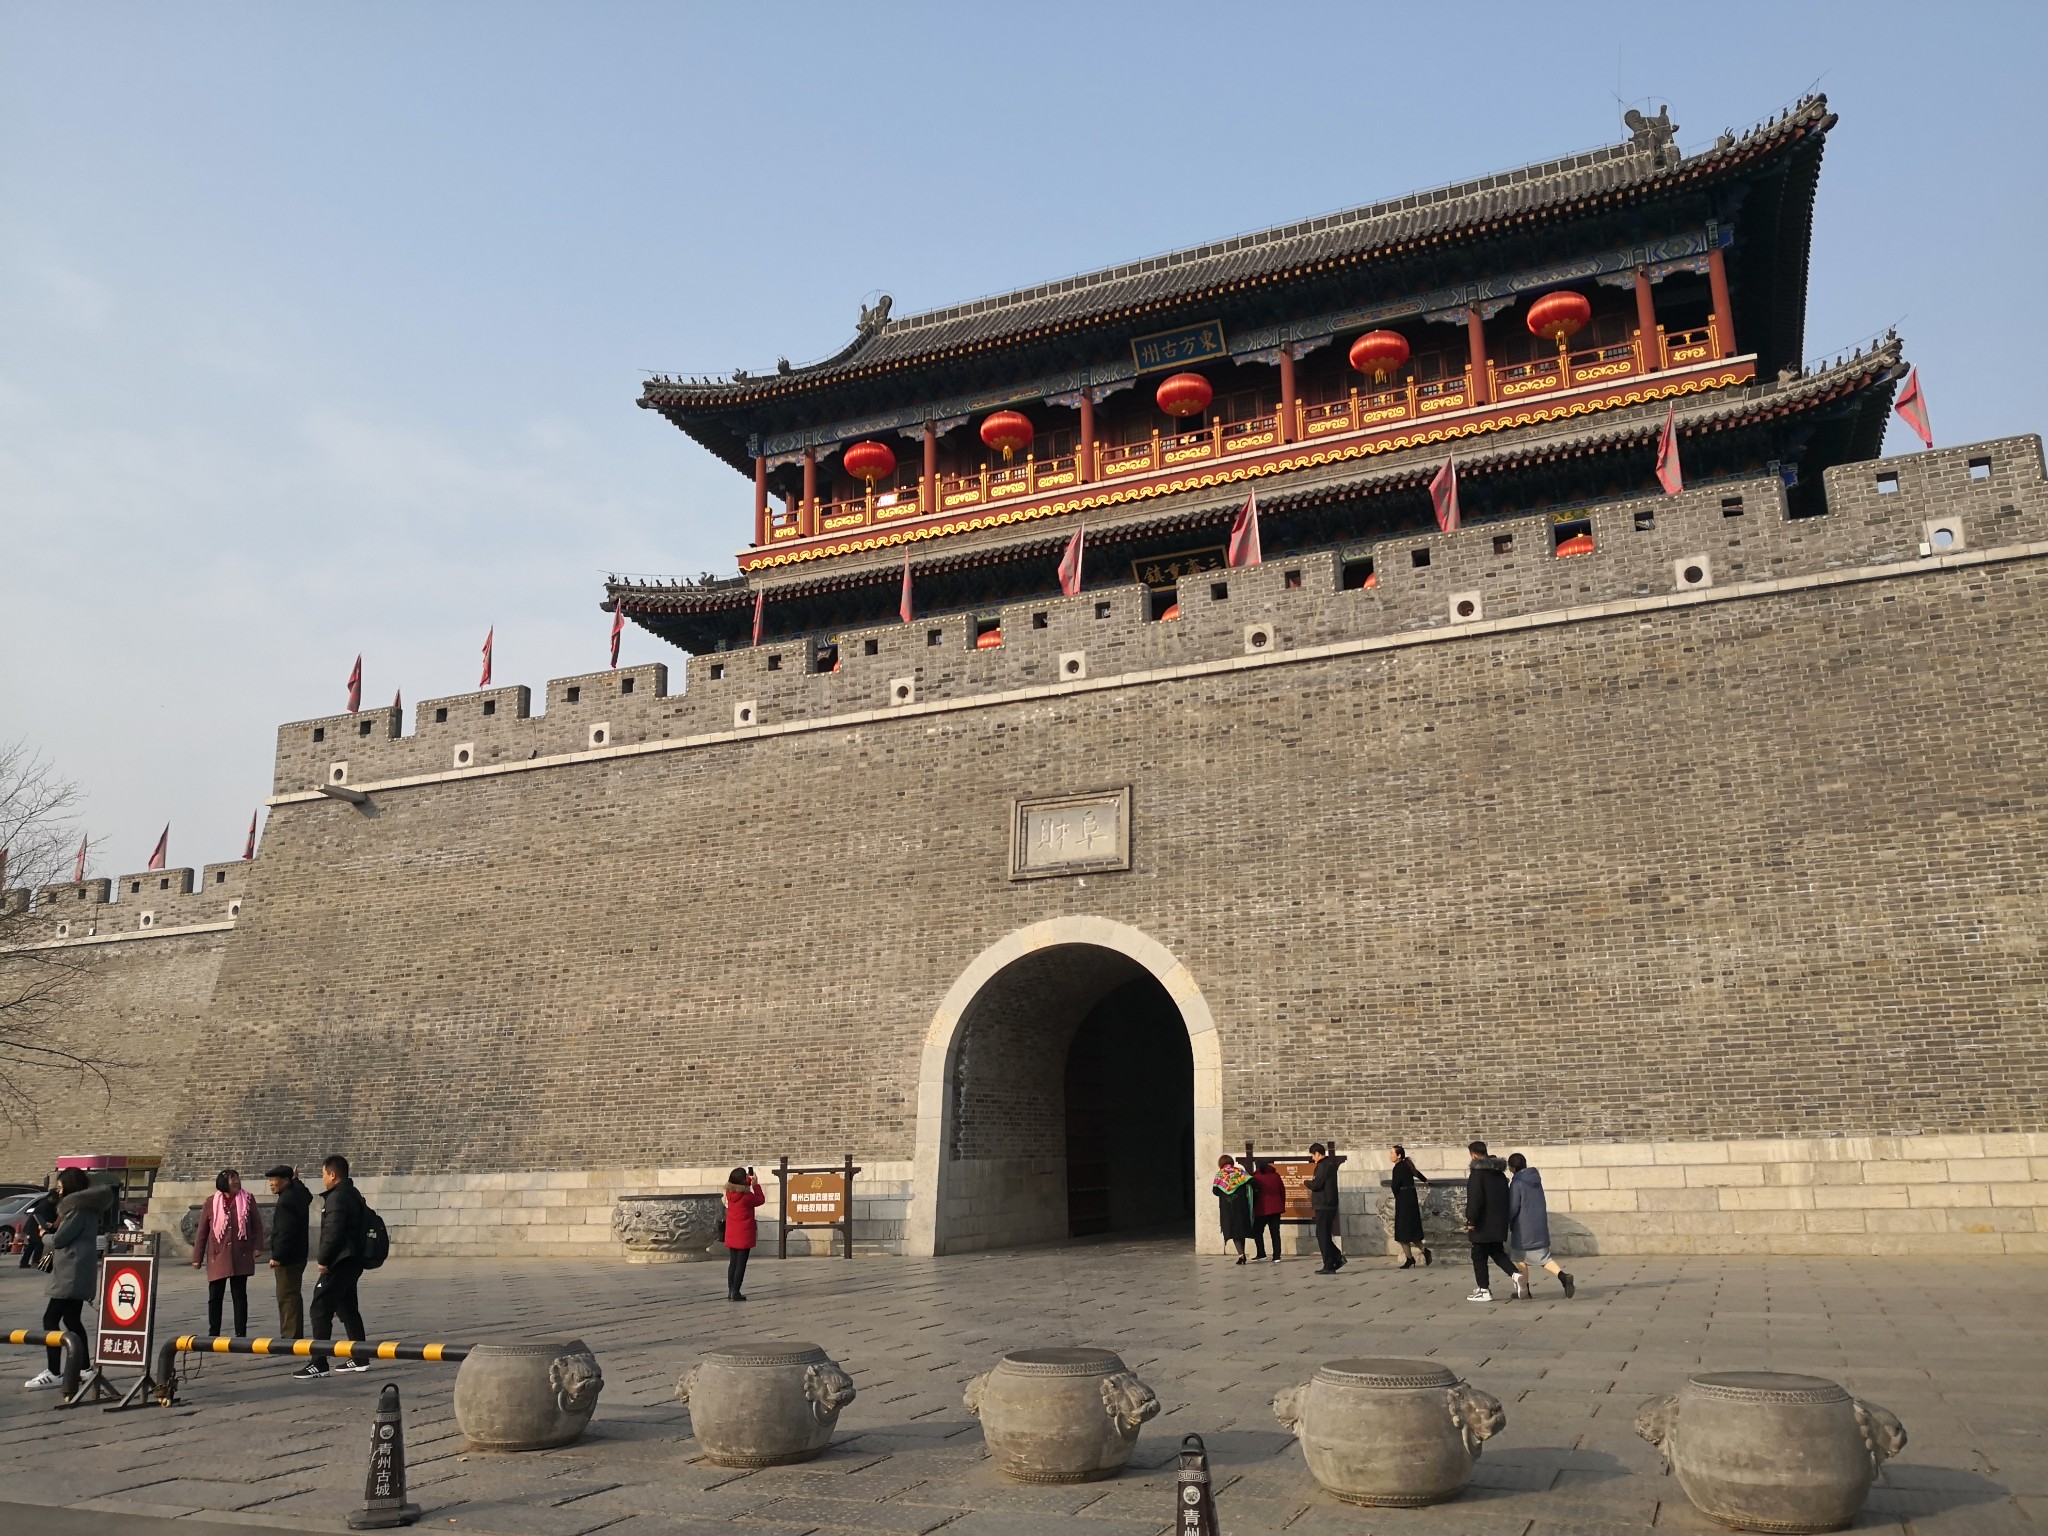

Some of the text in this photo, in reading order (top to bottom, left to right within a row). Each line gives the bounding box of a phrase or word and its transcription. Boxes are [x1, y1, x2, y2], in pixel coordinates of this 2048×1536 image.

[103, 1338, 142, 1356] 禁止驶入
[375, 1442, 393, 1496] 青州古城
